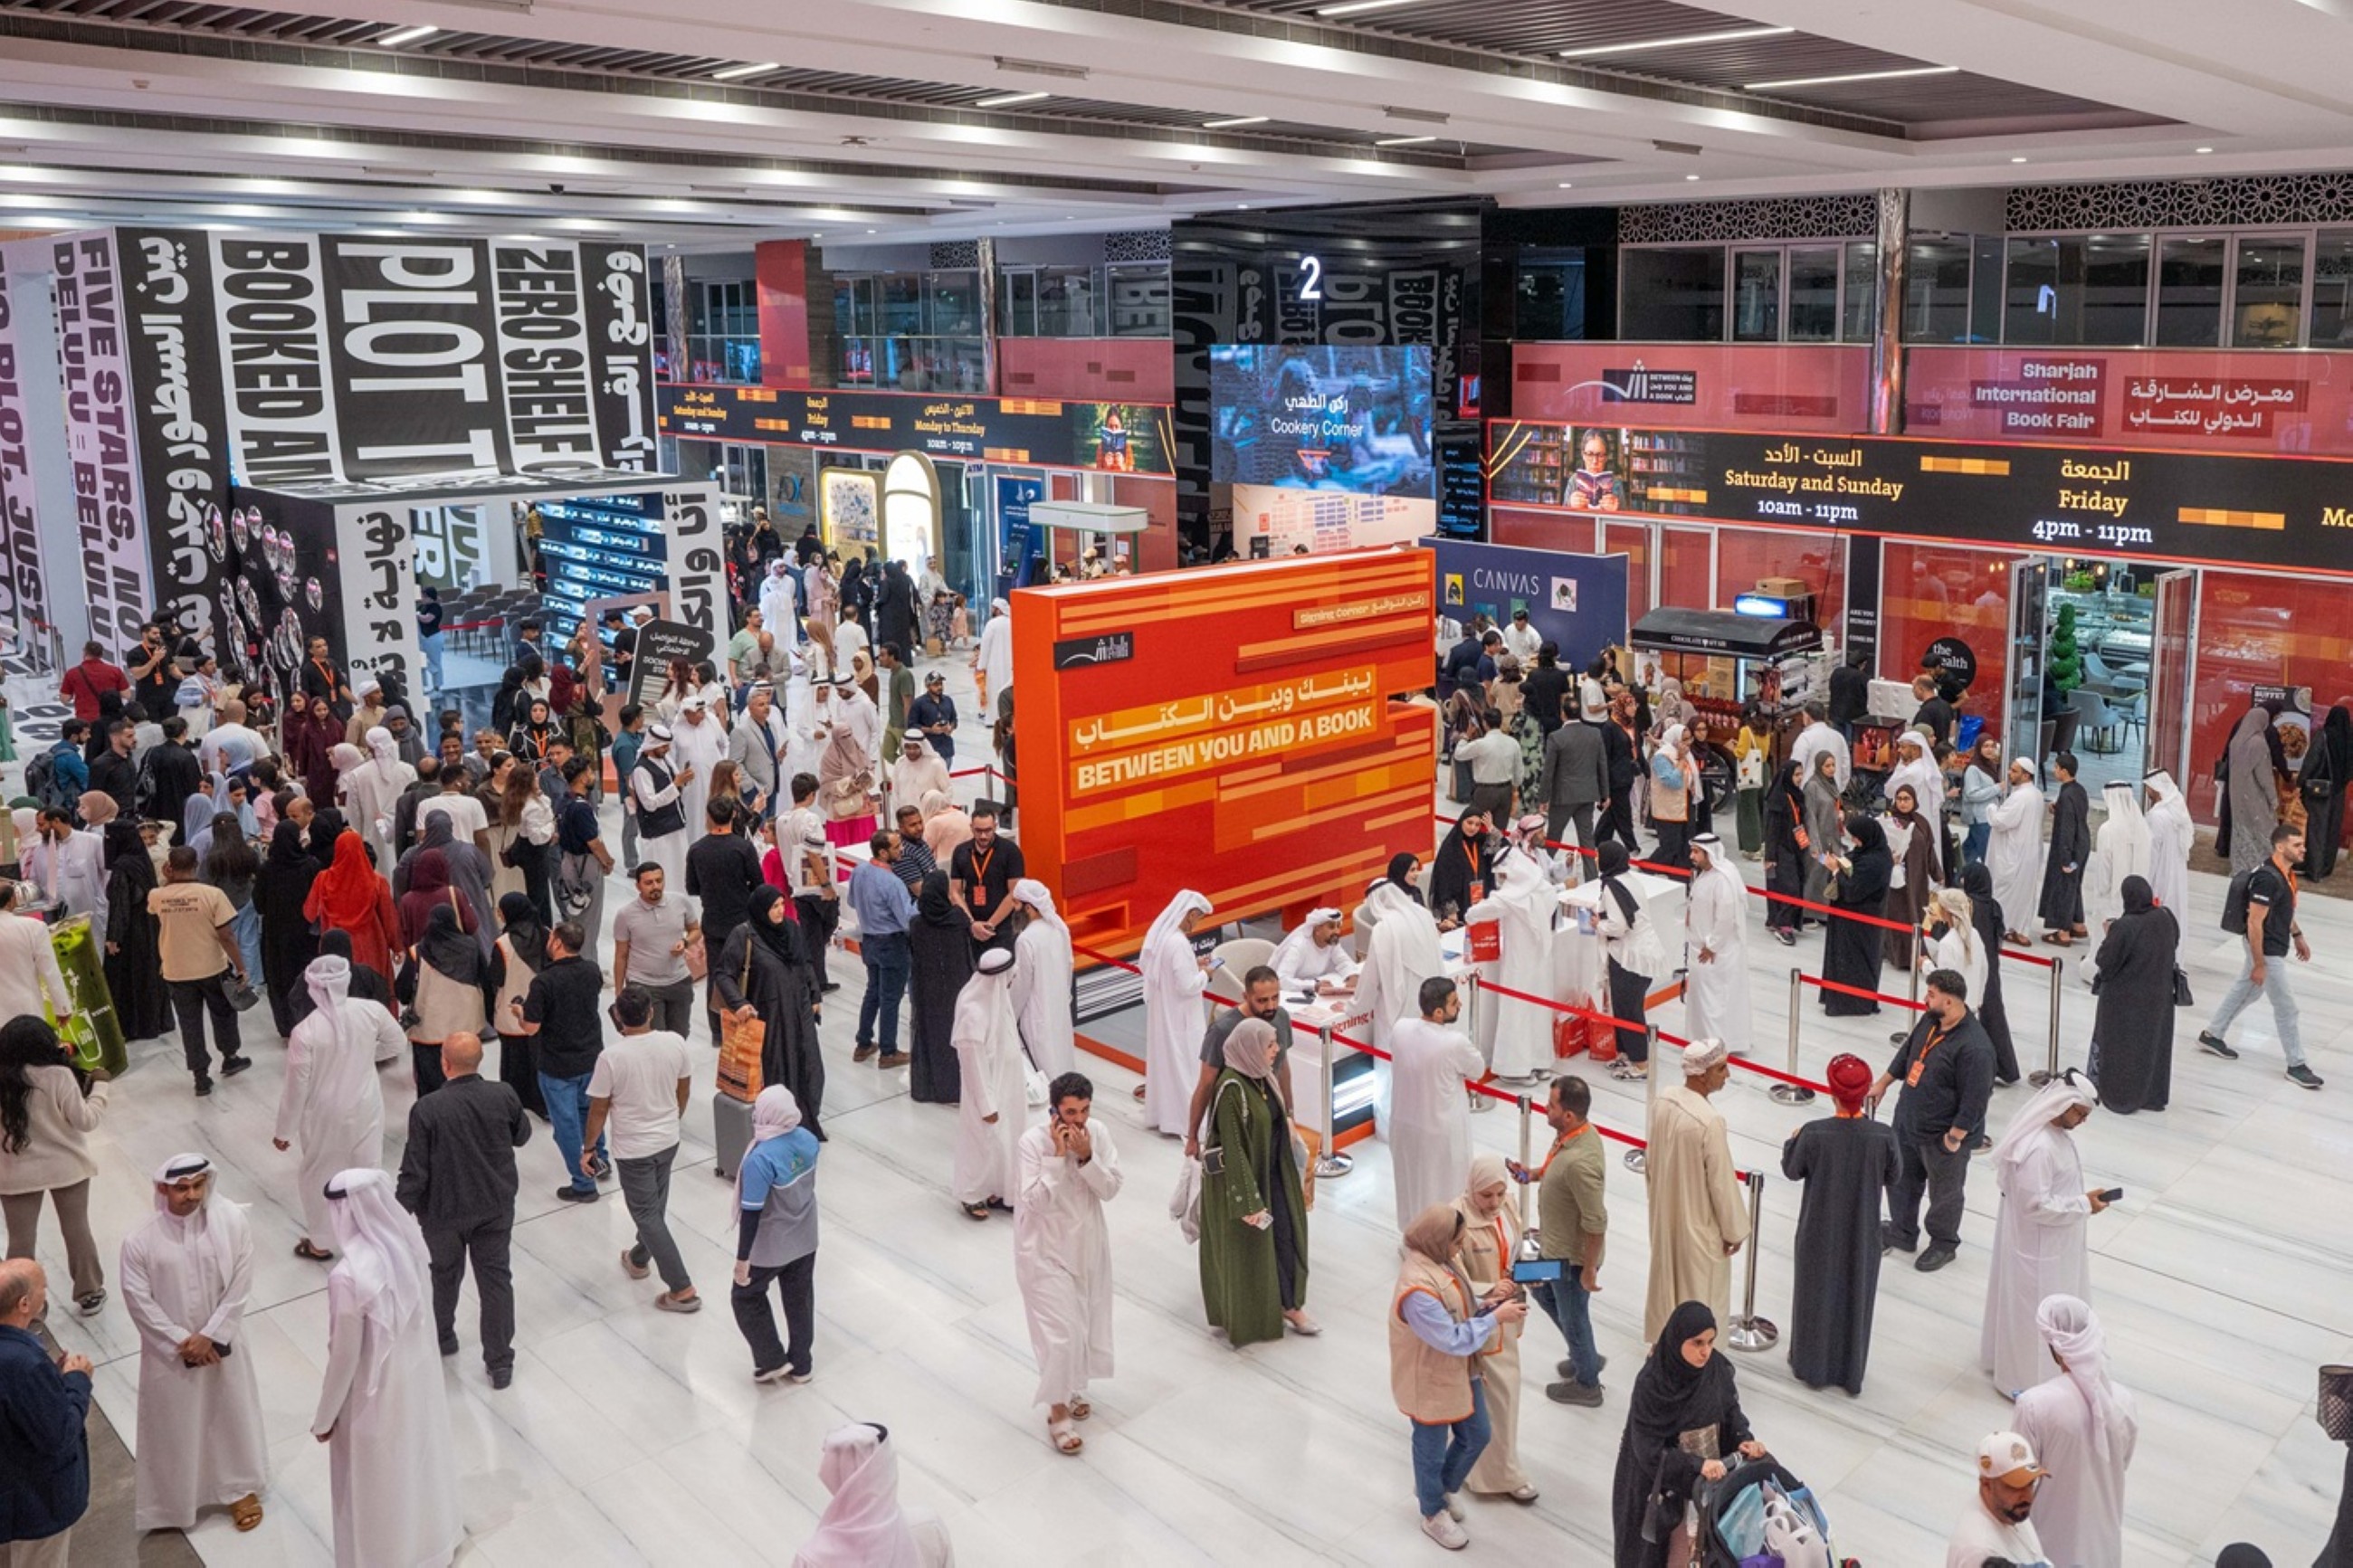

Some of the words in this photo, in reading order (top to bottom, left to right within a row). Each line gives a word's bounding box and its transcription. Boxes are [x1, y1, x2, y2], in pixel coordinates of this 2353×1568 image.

[135, 236, 189, 304] بين
[1300, 256, 1320, 299] 2
[80, 237, 119, 356] FIVE
[495, 247, 582, 340] ZERO
[596, 250, 649, 347] وضع
[221, 240, 324, 419] BOOKED
[338, 242, 490, 404] PLOT
[2023, 363, 2098, 380] Sharjah
[140, 314, 209, 461] السطور
[1976, 385, 2097, 404] International
[2131, 379, 2221, 404] الشارقة
[2224, 384, 2295, 406] معرض
[503, 347, 601, 460] SHELF
[1285, 394, 1326, 412] الطهي
[1329, 394, 1348, 412] ركن
[914, 420, 943, 434] Monday
[943, 421, 951, 432] to
[952, 421, 986, 437] Thursday
[1272, 418, 1319, 437] Cookery
[1322, 419, 1363, 437] Corner
[2006, 411, 2053, 429] Book
[2056, 413, 2095, 430] Fair
[2129, 408, 2200, 428] للكتاب
[2204, 411, 2262, 435] الدولي
[53, 242, 91, 423] DELULU
[73, 461, 113, 640] BELULU
[927, 439, 947, 450] 10am
[1765, 442, 1800, 463] الأحد
[93, 369, 136, 553] STARS,
[967, 463, 983, 472] ATM
[1813, 448, 1862, 470] السبت
[2061, 459, 2130, 484] الجمعة
[1725, 469, 1797, 494] Saturday
[1801, 474, 1834, 492] and
[1837, 476, 1903, 501] Sunday
[663, 492, 710, 537] أنا
[1758, 499, 1803, 516] 10am
[1815, 504, 1859, 523] 11pm
[2058, 489, 2129, 518] Friday
[166, 467, 214, 585] وجدت
[2033, 519, 2081, 541] 4pm
[2099, 526, 2153, 546] 11pm
[8, 494, 48, 635] JUST
[357, 510, 406, 611] نهاية
[1474, 567, 1539, 595] CANVAS
[1300, 610, 1335, 624] Signing
[1336, 605, 1369, 619] Corner
[370, 619, 404, 641] لا
[1933, 643, 1952, 656] the
[1940, 656, 1968, 670] ealth
[1298, 670, 1372, 701] بينك
[1219, 685, 1293, 721] وبين
[1076, 697, 1214, 750] الكتاب
[1078, 743, 1195, 791] BETWEEN
[1198, 728, 1244, 763] YOU
[1248, 720, 1295, 753] AND
[1299, 718, 1314, 741] A
[1317, 707, 1373, 737] BOOK
[1329, 1014, 1369, 1033] igning
